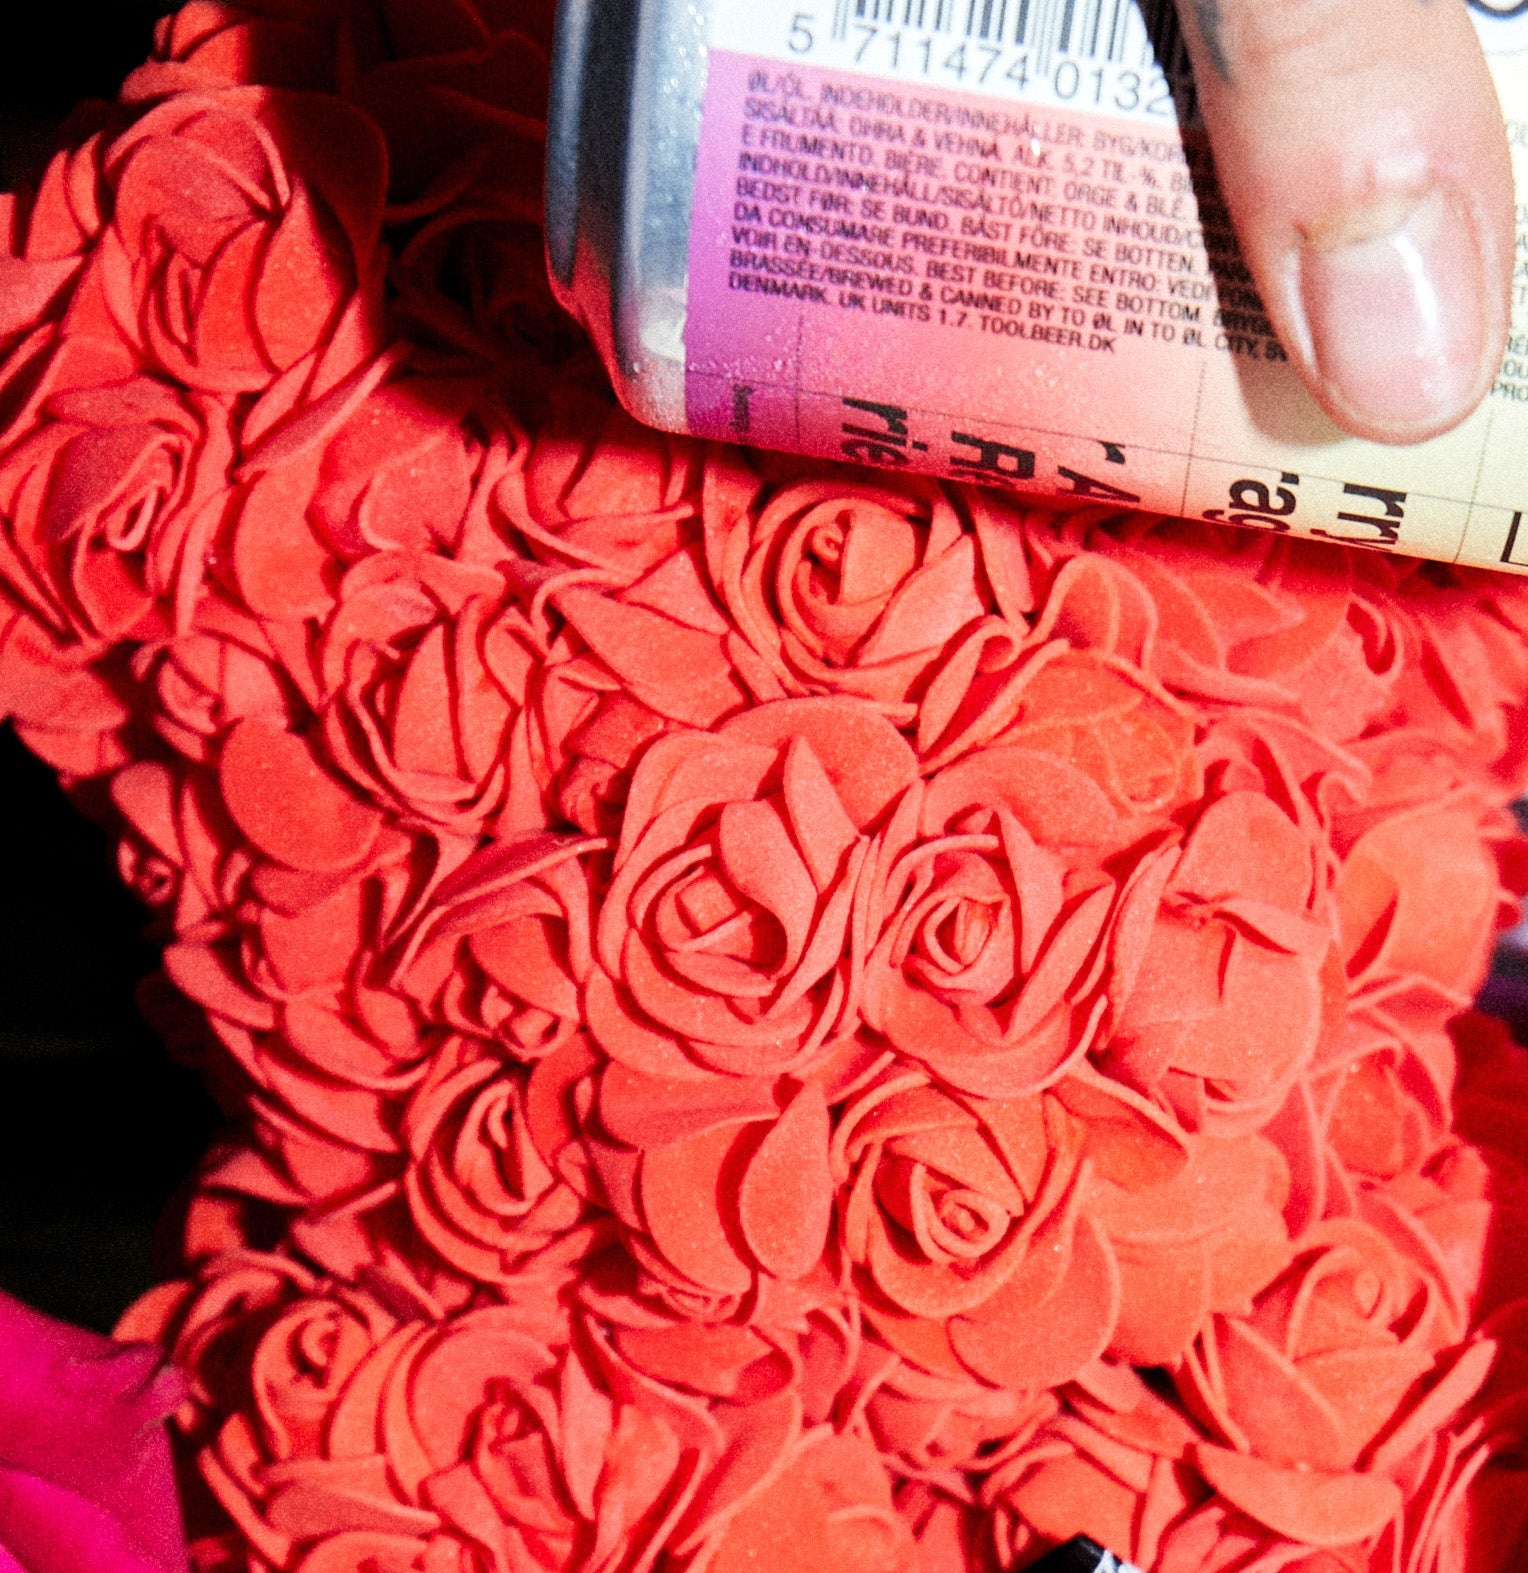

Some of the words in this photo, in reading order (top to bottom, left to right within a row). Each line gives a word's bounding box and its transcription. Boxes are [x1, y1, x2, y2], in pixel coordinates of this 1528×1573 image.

[787, 14, 815, 53] 5
[854, 27, 1031, 92] 711474
[742, 125, 752, 143] E
[1064, 182, 1116, 207] ORGE
[1126, 193, 1138, 211] &
[850, 117, 906, 142] OHRA
[913, 128, 925, 145] &
[734, 202, 761, 221] DA
[770, 209, 893, 244] CONSUMARE
[903, 232, 1081, 277] PREFERIBILMENTE
[737, 178, 799, 202] BEDST
[862, 200, 884, 217] SE
[1085, 239, 1105, 256] SE
[731, 226, 777, 248] VOIR
[926, 261, 975, 283] BEST
[1073, 287, 1107, 306] SEE
[839, 292, 865, 309] UK
[873, 298, 929, 320] UNITS
[980, 317, 1115, 353] TOOLBEER.DK
[921, 283, 932, 299] &
[941, 287, 1021, 314] CANNED
[1029, 302, 1052, 320] BY
[1061, 308, 1084, 325] TO
[1093, 314, 1113, 330] ØL
[1125, 319, 1143, 336] IN
[1151, 324, 1174, 341] TO
[1183, 330, 1204, 347] ØL
[1310, 482, 1408, 553] rry
